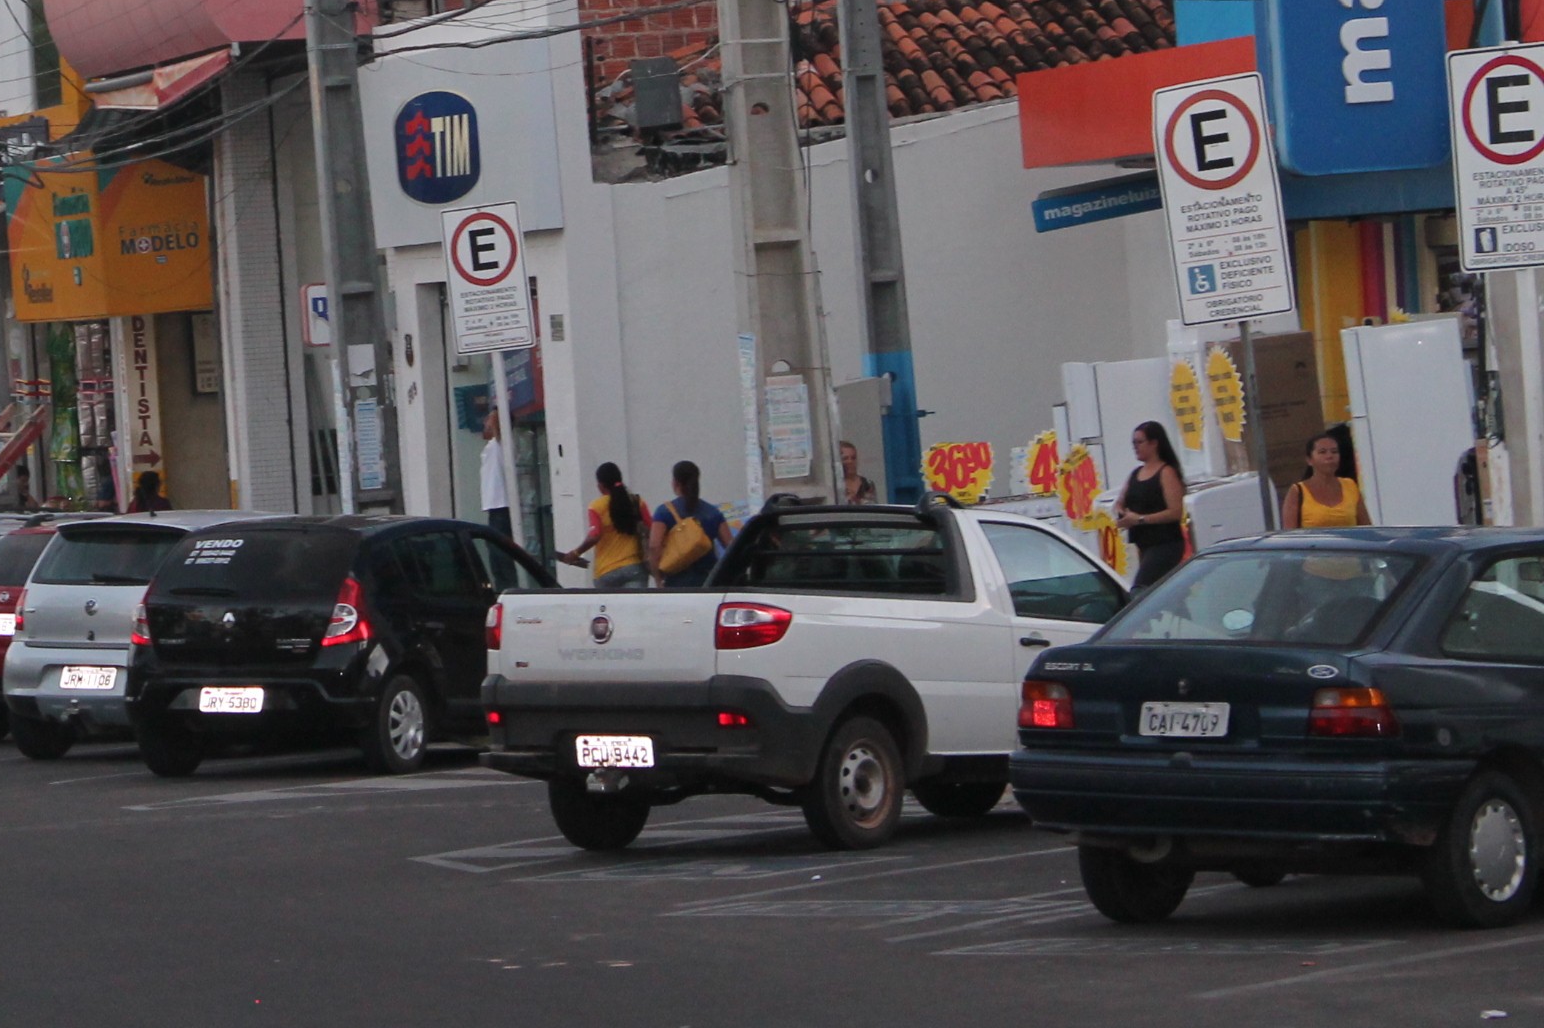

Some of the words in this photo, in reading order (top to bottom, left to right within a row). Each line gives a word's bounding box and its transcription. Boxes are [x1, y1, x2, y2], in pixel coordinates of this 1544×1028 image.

[1486, 73, 1535, 144] E
[431, 113, 471, 178] TIM
[1190, 108, 1234, 172] E
[1180, 193, 1263, 213] ESTACIONAMENTO
[1187, 209, 1232, 223] ROTATIVO
[1233, 204, 1259, 216] PAGO
[1230, 214, 1263, 226] HORAS
[120, 232, 200, 255] MODELO
[469, 227, 499, 271] E
[1502, 241, 1536, 253] IDOSO
[1219, 255, 1272, 270] EXCLUSIVO
[1220, 265, 1275, 280] DEFICIENTE
[1209, 305, 1263, 318] CREDENCIAL
[132, 314, 154, 447] DENTISTA
[195, 538, 245, 550] VENDO
